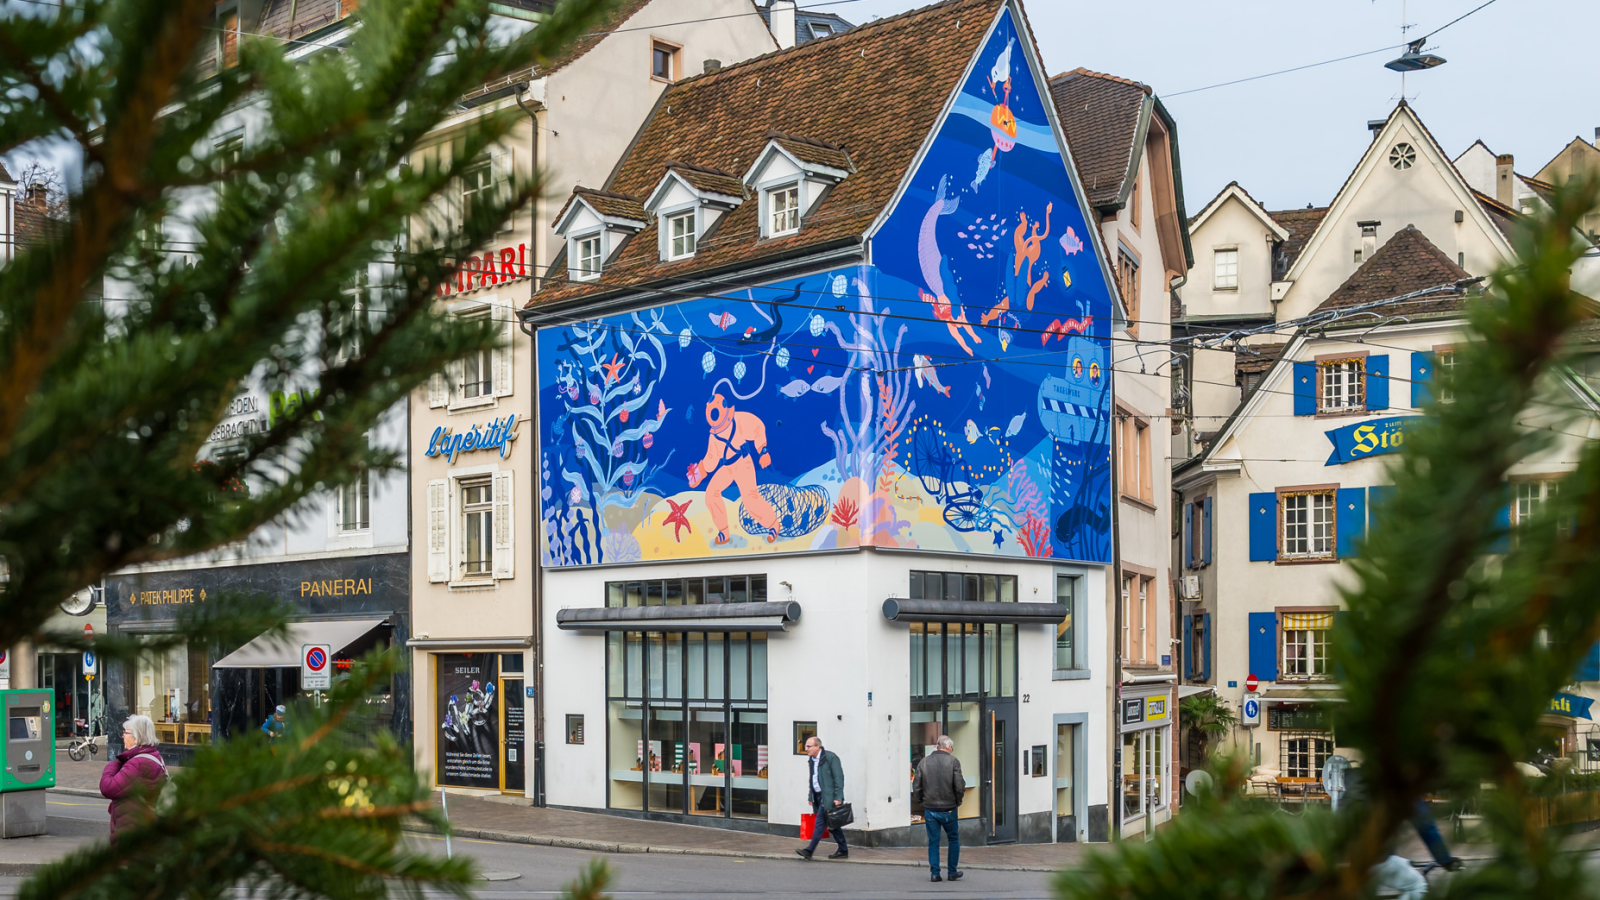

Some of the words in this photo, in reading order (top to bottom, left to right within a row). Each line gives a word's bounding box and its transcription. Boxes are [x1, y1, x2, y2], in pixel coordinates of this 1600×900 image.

[436, 243, 526, 298] MPARI
[425, 414, 514, 463] l'apéritif
[1350, 424, 1404, 457] Stö
[140, 590, 161, 605] PATEK
[162, 588, 194, 604] PHILIPPE
[301, 577, 372, 598] PANERAI
[455, 666, 480, 674] SEILER
[1022, 693, 1031, 703] 22
[1551, 696, 1571, 712] kli
